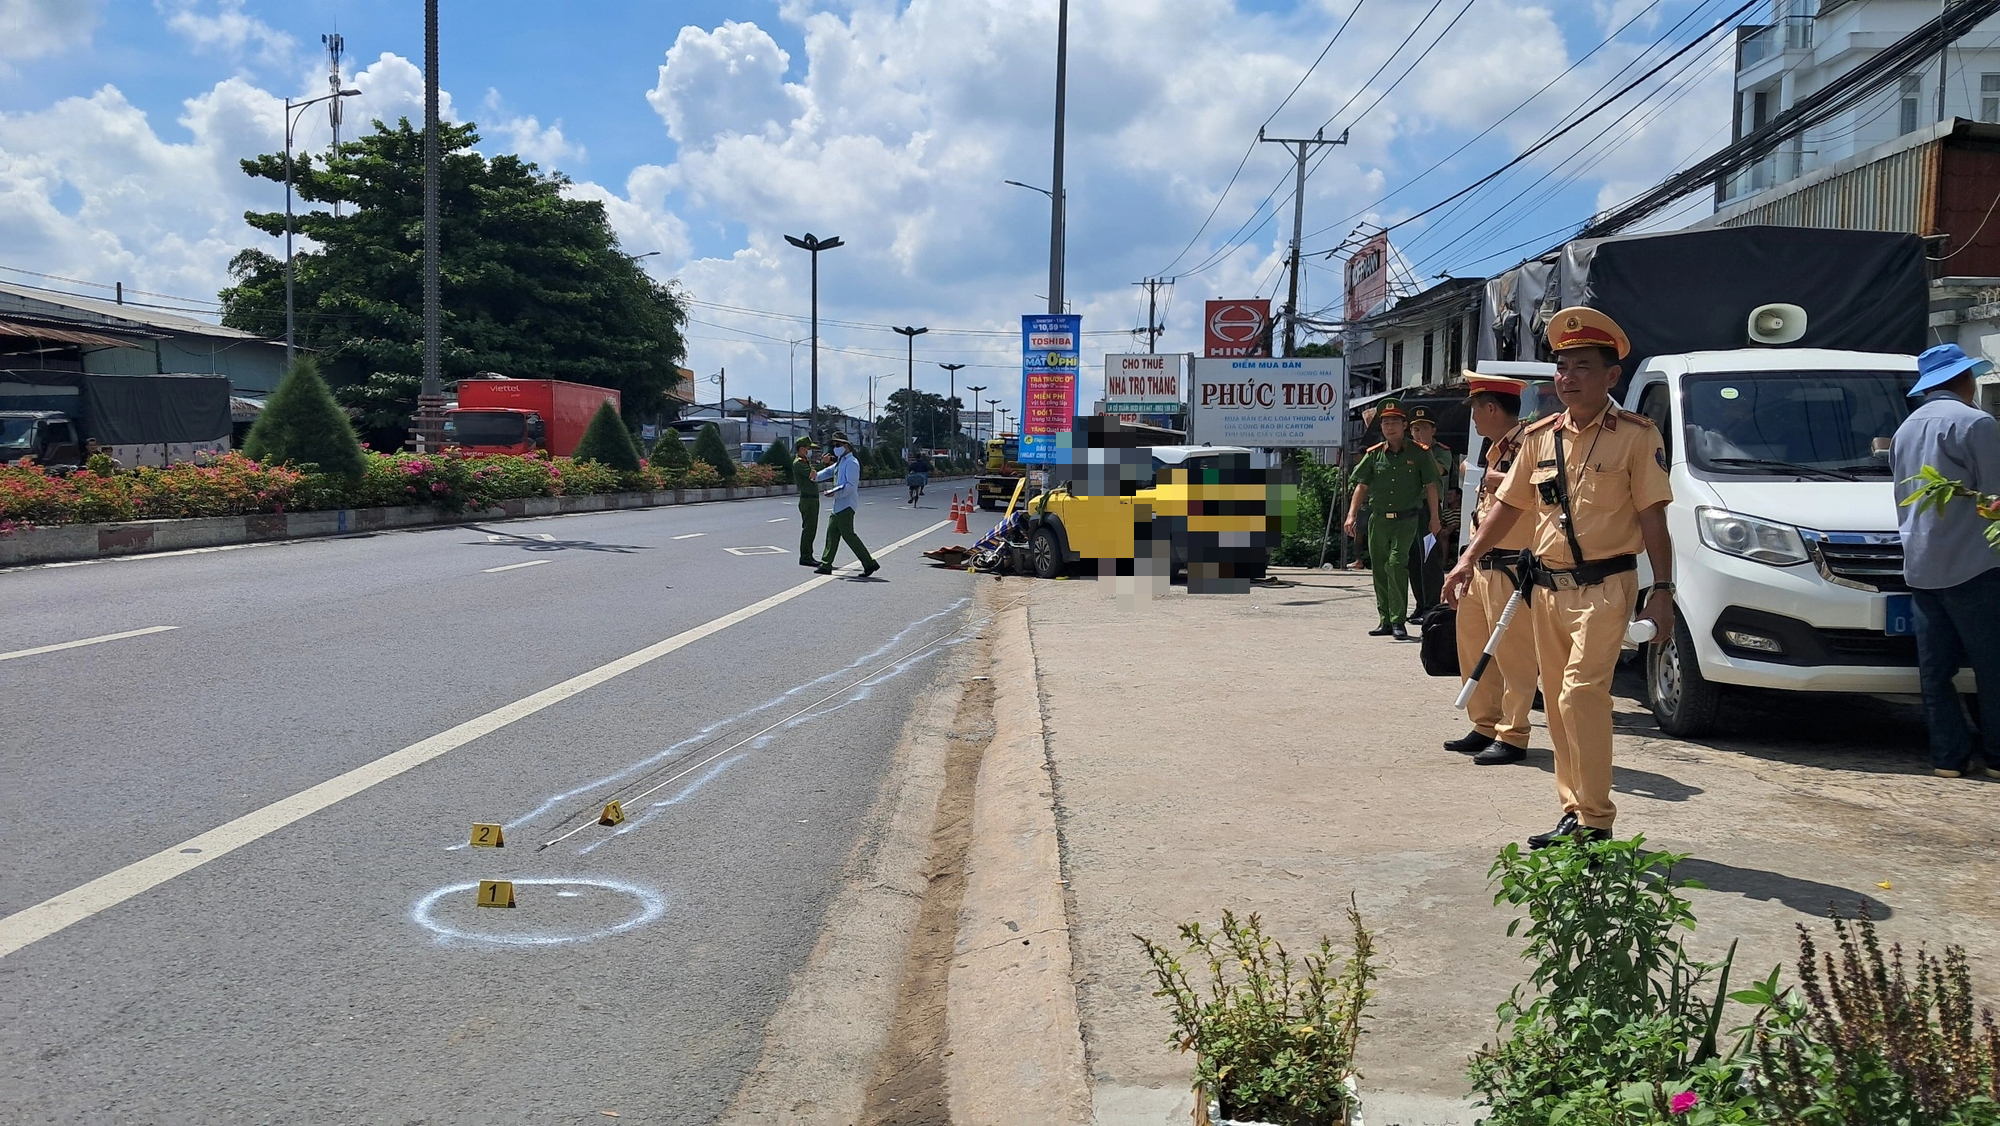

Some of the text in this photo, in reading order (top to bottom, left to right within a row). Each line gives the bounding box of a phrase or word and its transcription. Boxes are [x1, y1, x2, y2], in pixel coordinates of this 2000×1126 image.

[1039, 324, 1059, 332] 10,59
[1031, 338, 1071, 346] TOSHIBA
[1059, 355, 1078, 367] PHÍ
[1122, 356, 1164, 370] CHO THUÊ
[1109, 370, 1176, 401] NHÀ TRỌ THÁNG
[1053, 392, 1066, 400] PHÍ
[1201, 378, 1336, 412] PHÚC THỌ
[613, 805, 620, 819] 3
[478, 827, 490, 842] 2
[488, 883, 497, 902] 1
